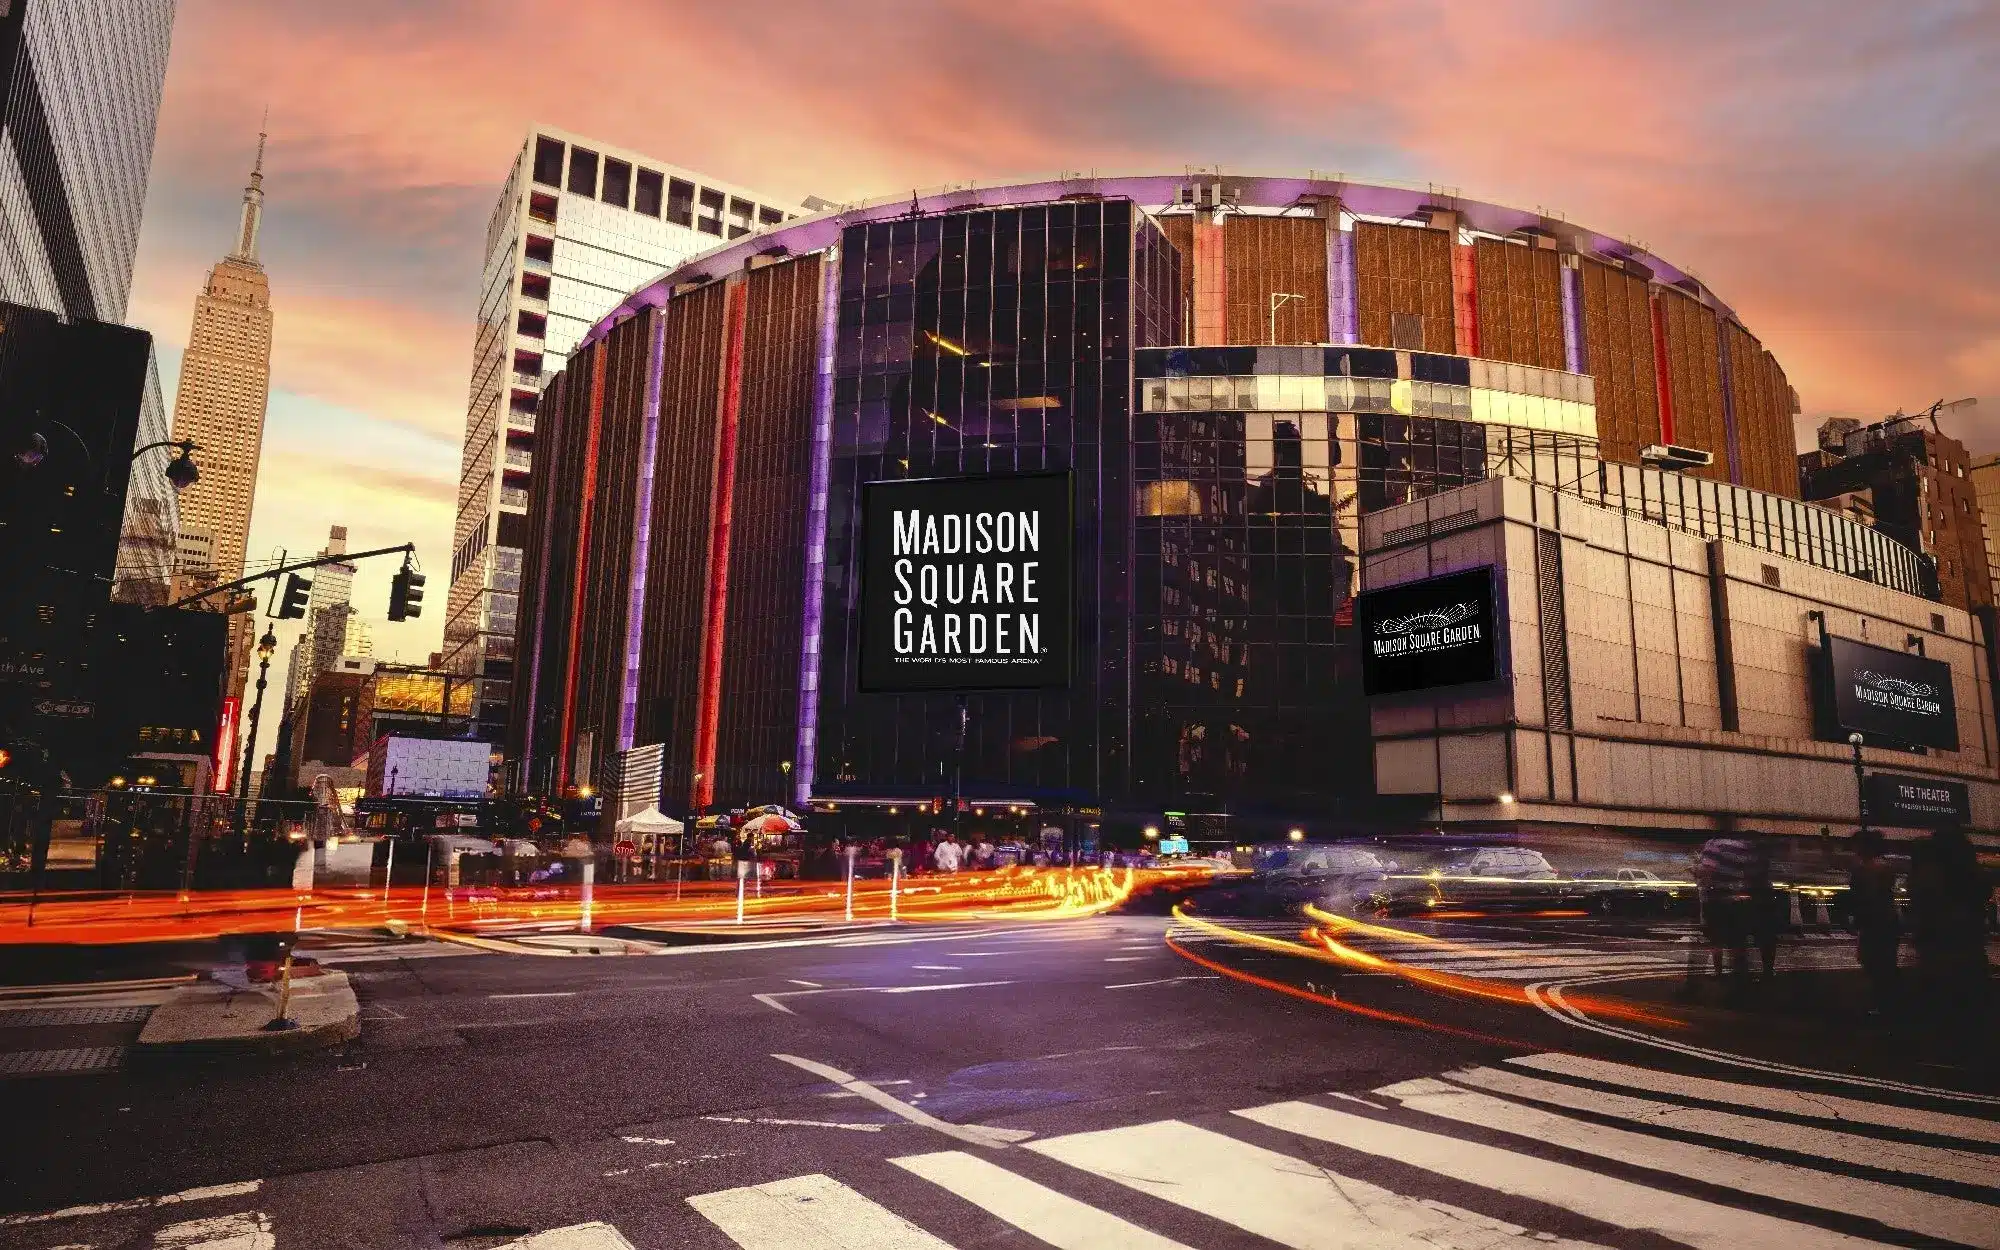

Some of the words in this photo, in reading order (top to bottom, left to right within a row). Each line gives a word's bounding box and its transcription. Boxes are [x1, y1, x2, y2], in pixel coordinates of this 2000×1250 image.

[893, 509, 1039, 556] MADISON
[893, 558, 1039, 609] SQUARE
[893, 607, 1039, 654] GARDEN
[1373, 636, 1407, 655] MADISON
[1409, 630, 1441, 649] SQUARE
[1443, 624, 1480, 644] GARDEN
[18, 664, 45, 675] Ave
[1855, 684, 1889, 704] MADISON
[1889, 692, 1915, 709] SQUARE
[1916, 697, 1940, 713] GARDEN
[1898, 785, 1915, 799] THE
[1916, 787, 1951, 802] THEATER
[616, 846, 635, 856] STOP
